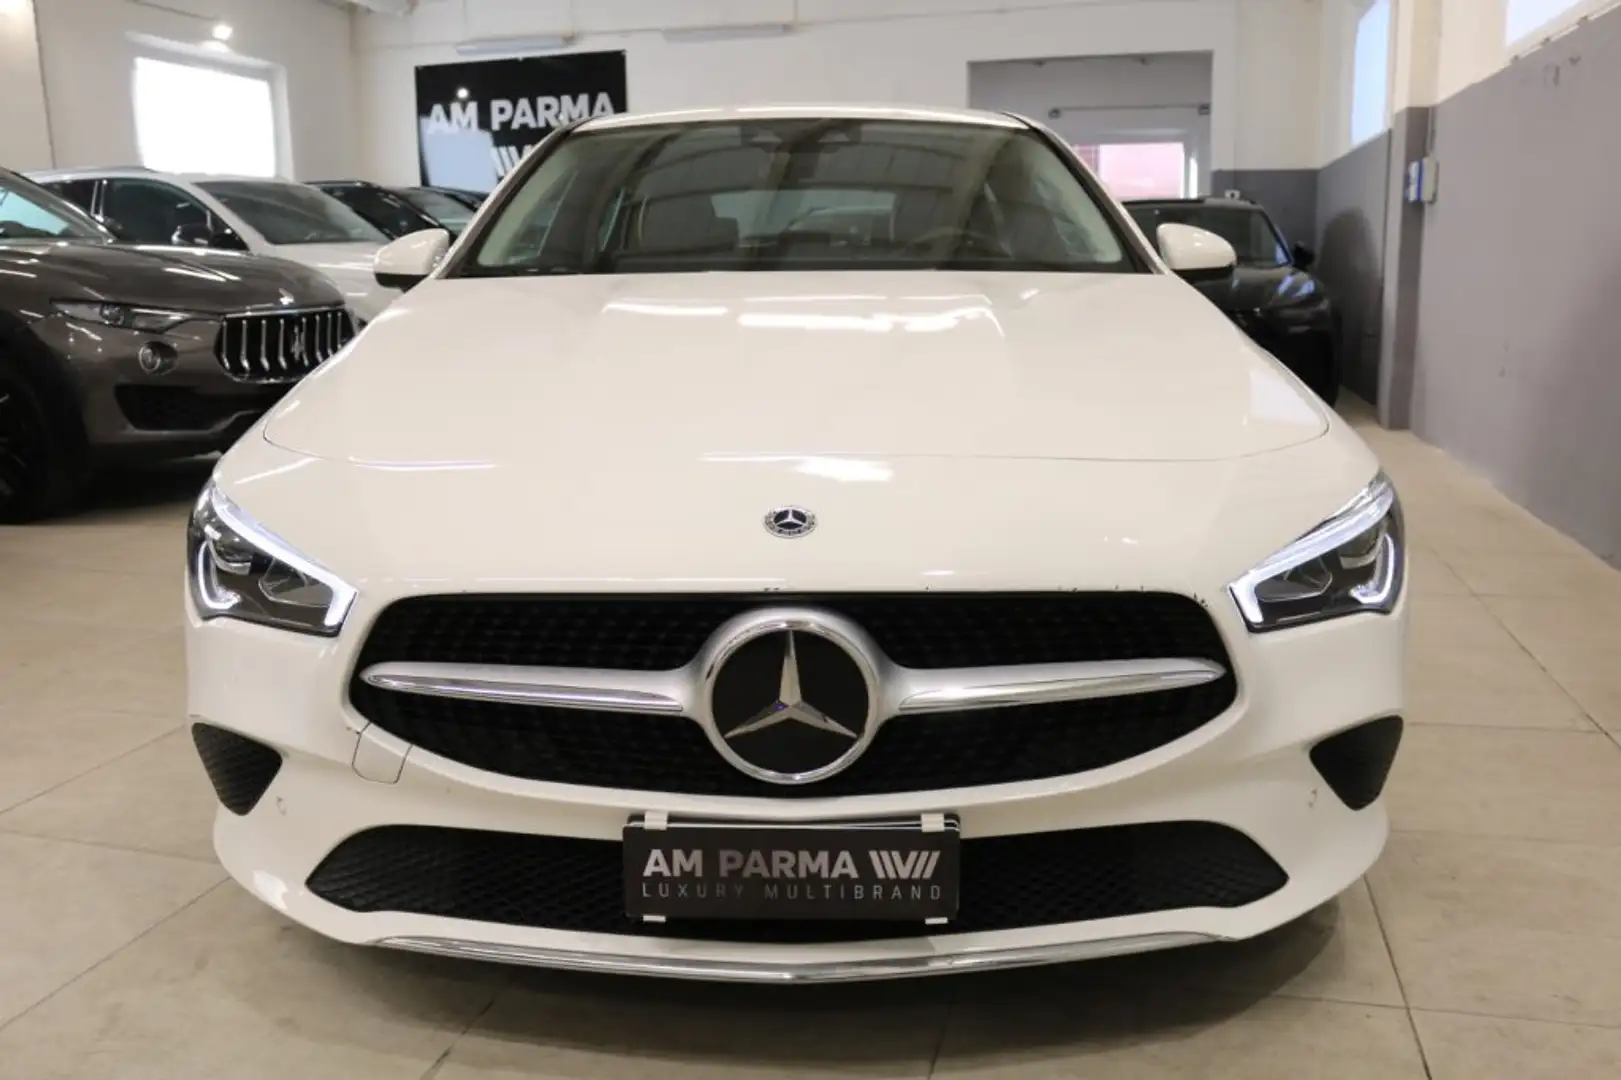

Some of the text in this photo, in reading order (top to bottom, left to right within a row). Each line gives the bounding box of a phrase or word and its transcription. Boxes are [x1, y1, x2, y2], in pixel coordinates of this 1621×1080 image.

[427, 92, 615, 135] AM PARMA
[643, 849, 859, 879] AM PARMA
[642, 882, 941, 900] LUXURY MULTIBRAND
